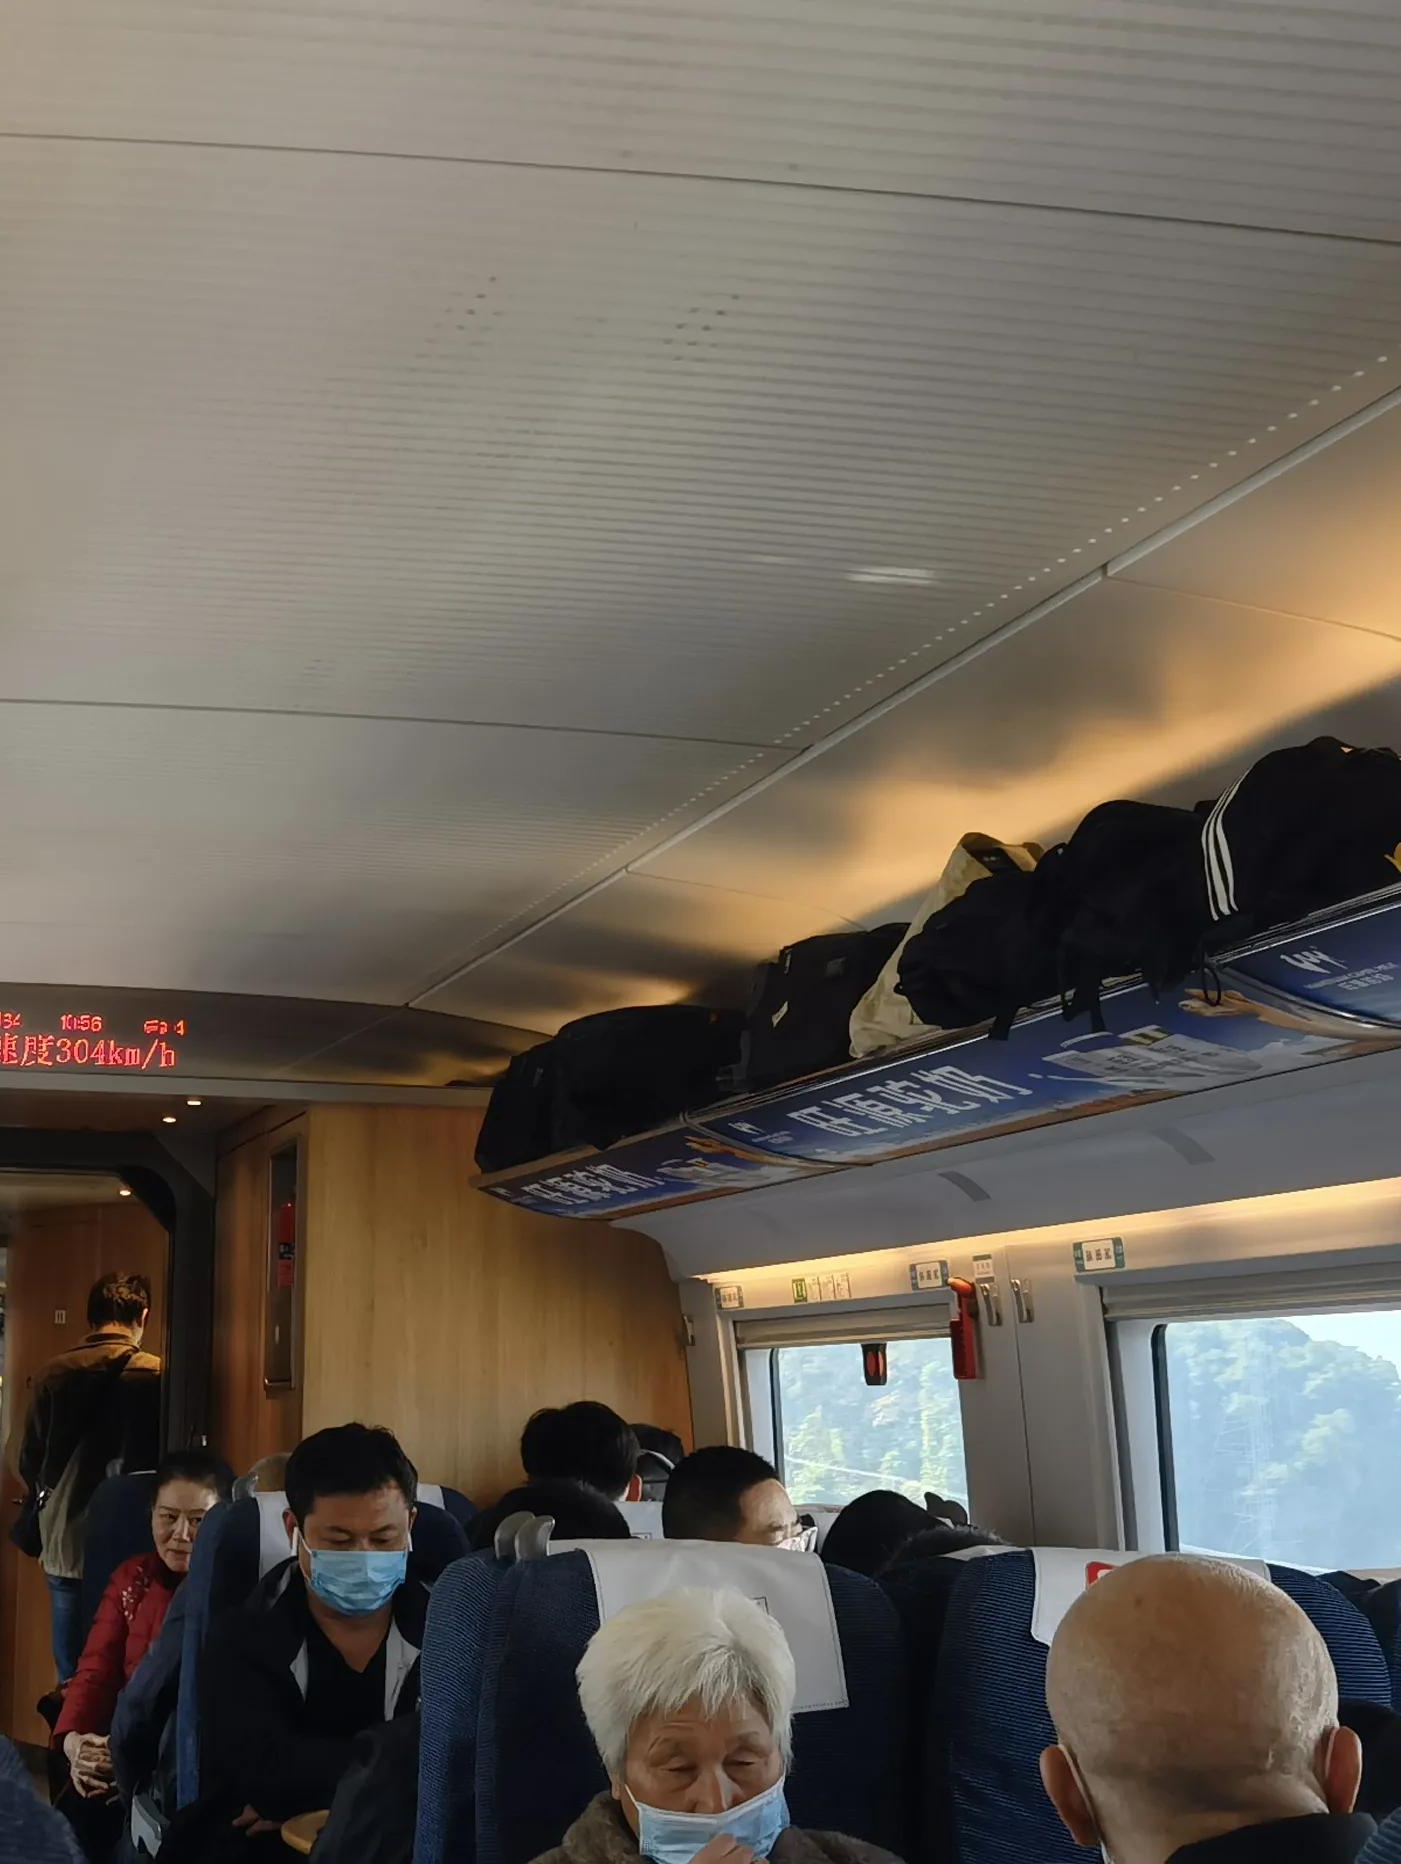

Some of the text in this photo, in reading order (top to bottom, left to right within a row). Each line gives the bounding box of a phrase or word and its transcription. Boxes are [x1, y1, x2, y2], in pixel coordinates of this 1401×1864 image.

[60, 1014, 103, 1032] 10:56
[786, 1065, 1034, 1137] 旺源驼奶
